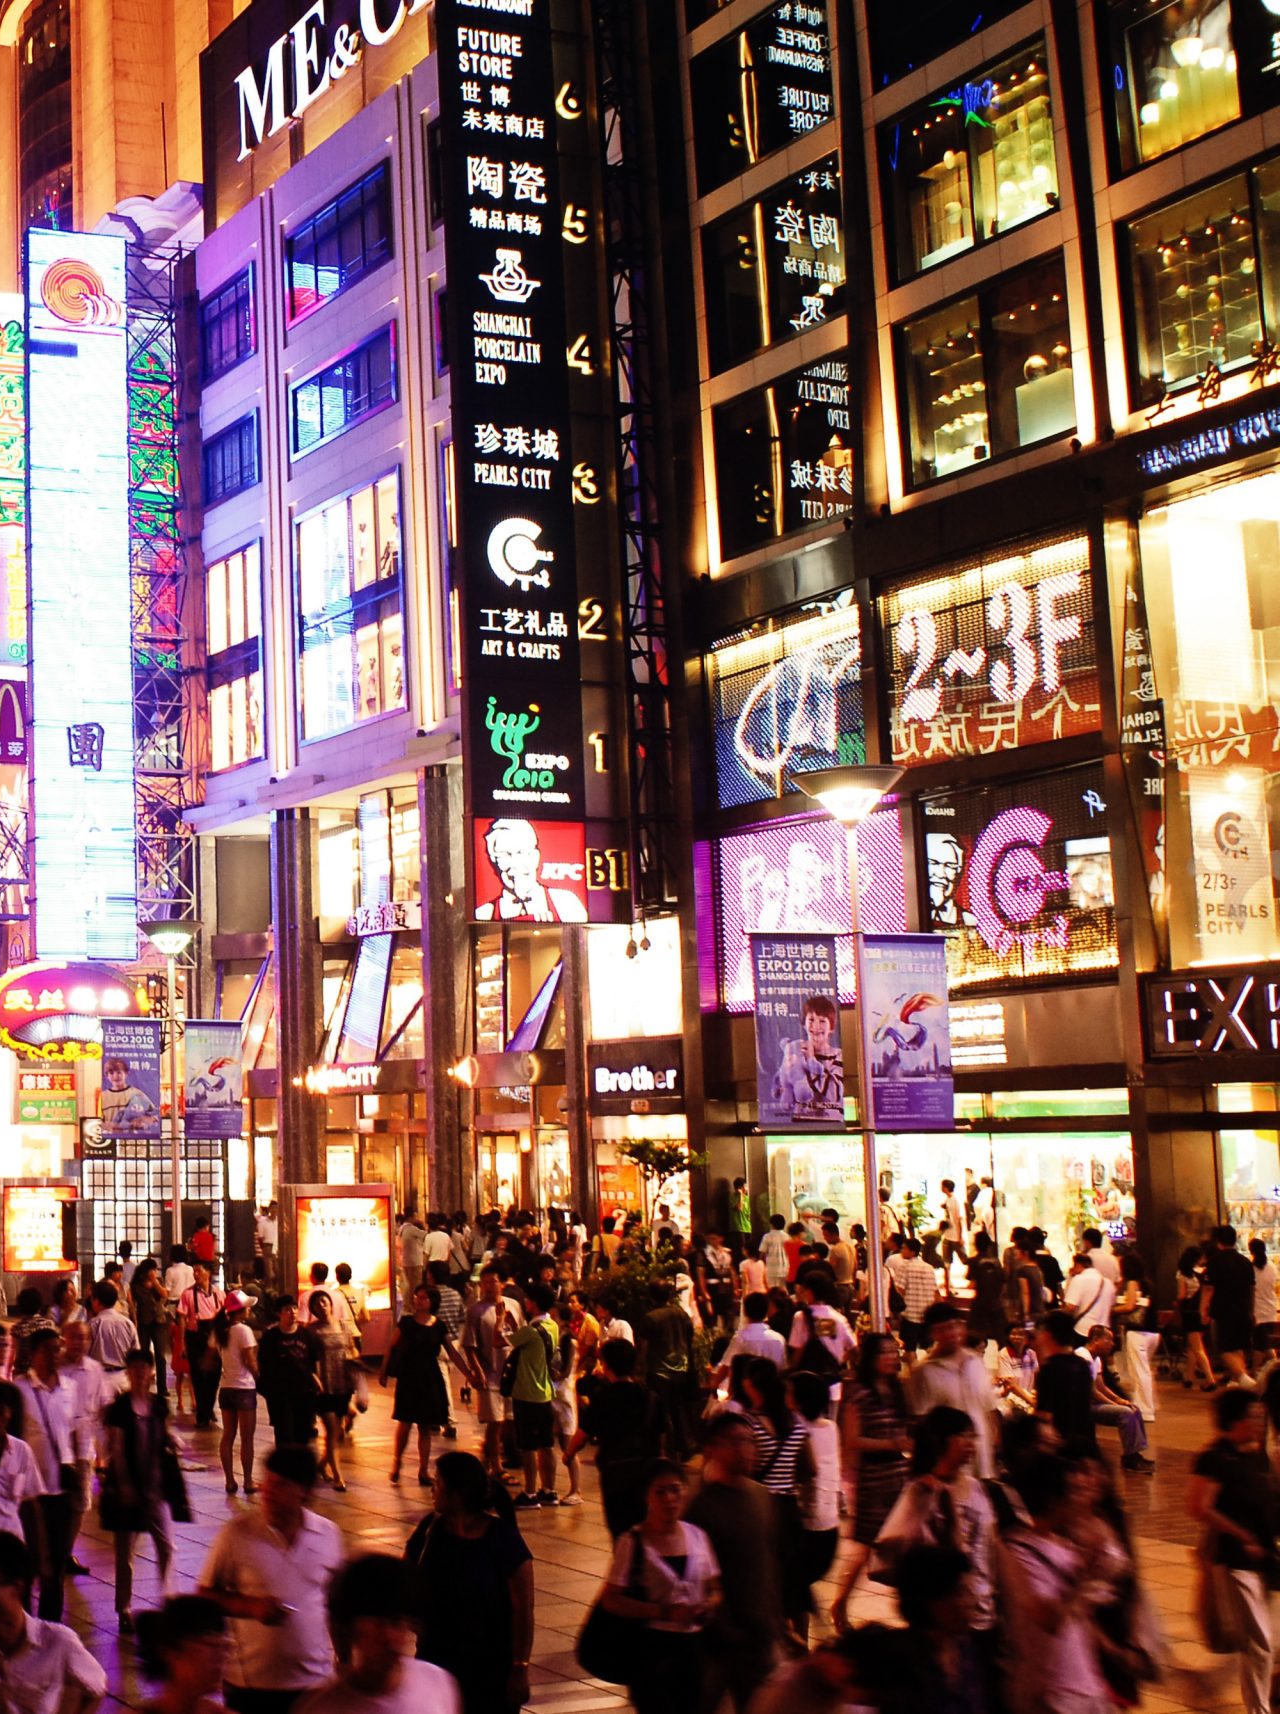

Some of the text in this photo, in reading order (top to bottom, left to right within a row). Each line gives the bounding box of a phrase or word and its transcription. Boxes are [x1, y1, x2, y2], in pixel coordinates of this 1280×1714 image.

[456, 0, 533, 17] AURANT
[457, 27, 523, 57] FUTURE
[458, 52, 514, 79] STORE
[234, 0, 434, 162] ME&
[460, 81, 511, 108] 世博
[555, 81, 583, 120] 6
[462, 109, 545, 139] 未来商店
[467, 156, 548, 204] 陶瓷
[469, 207, 542, 236] 精品商场
[562, 203, 589, 243] 5
[473, 312, 532, 338] SHANGHAI
[474, 336, 541, 363] PORCELAIN
[567, 335, 594, 375] 4
[475, 362, 506, 385] EXPO
[474, 424, 560, 462] 珍珠城
[474, 462, 551, 491] PEARLS CITY
[572, 462, 601, 504] 3
[480, 609, 568, 638] 工艺礼品
[578, 597, 607, 641] 2
[481, 638, 505, 656] ART
[518, 643, 561, 660] CRAFTS
[524, 752, 570, 771] EXPO
[588, 731, 609, 774] 1
[540, 862, 586, 880] KFC
[586, 848, 630, 891] B1
[1205, 902, 1269, 919] PEARLS
[1207, 921, 1245, 935] CITY
[757, 943, 829, 958] 上海世博会
[757, 959, 830, 973] EXPO 2010
[758, 972, 831, 981] SHANGHAI CHINA
[105, 1035, 155, 1044] EXPO 2010
[595, 1066, 678, 1095] Brother
